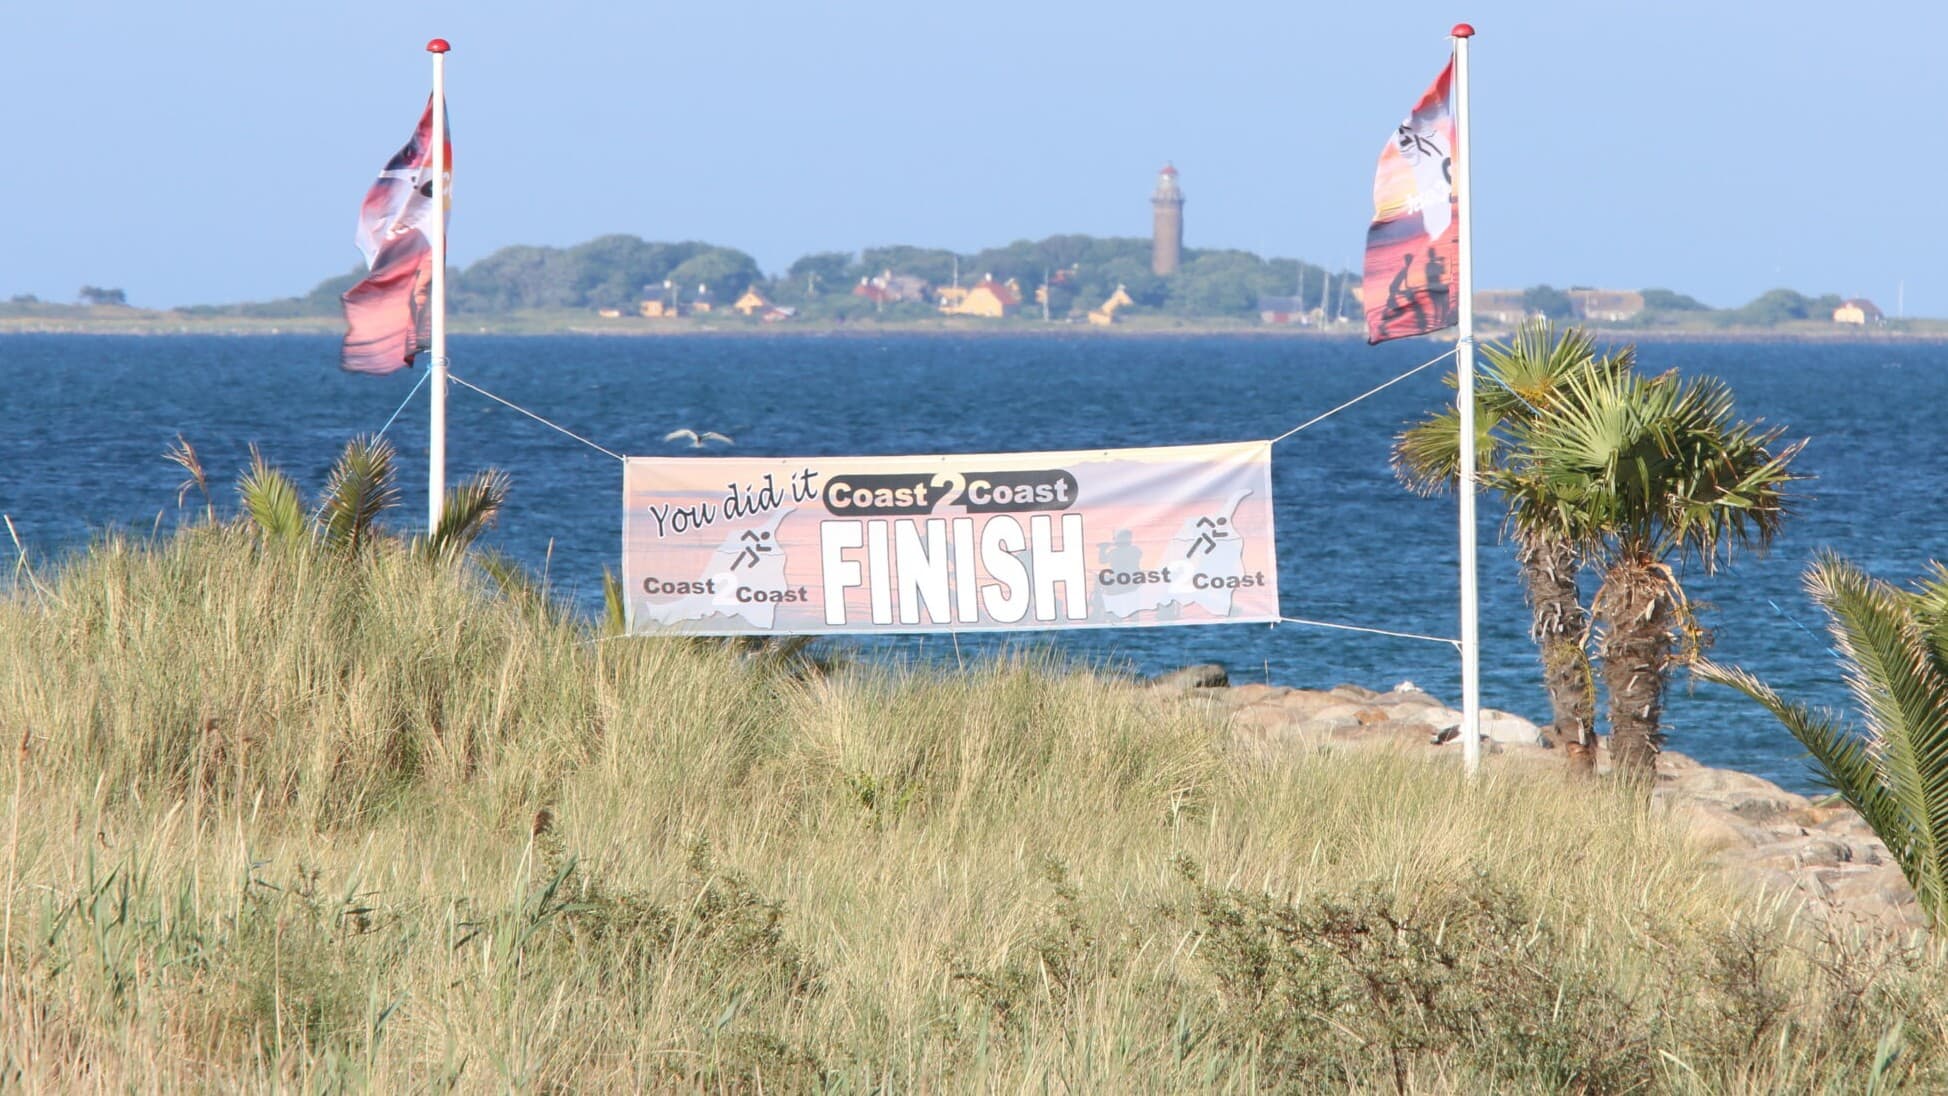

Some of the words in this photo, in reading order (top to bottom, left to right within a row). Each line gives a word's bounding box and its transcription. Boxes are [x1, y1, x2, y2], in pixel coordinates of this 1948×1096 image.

[650, 503, 716, 537] You
[724, 474, 783, 520] did
[791, 468, 818, 500] it
[643, 576, 716, 595] Coast
[735, 585, 809, 603] Coast
[820, 514, 1088, 626] FINISH
[1098, 565, 1172, 587] Coast
[1192, 570, 1265, 590] Coast
